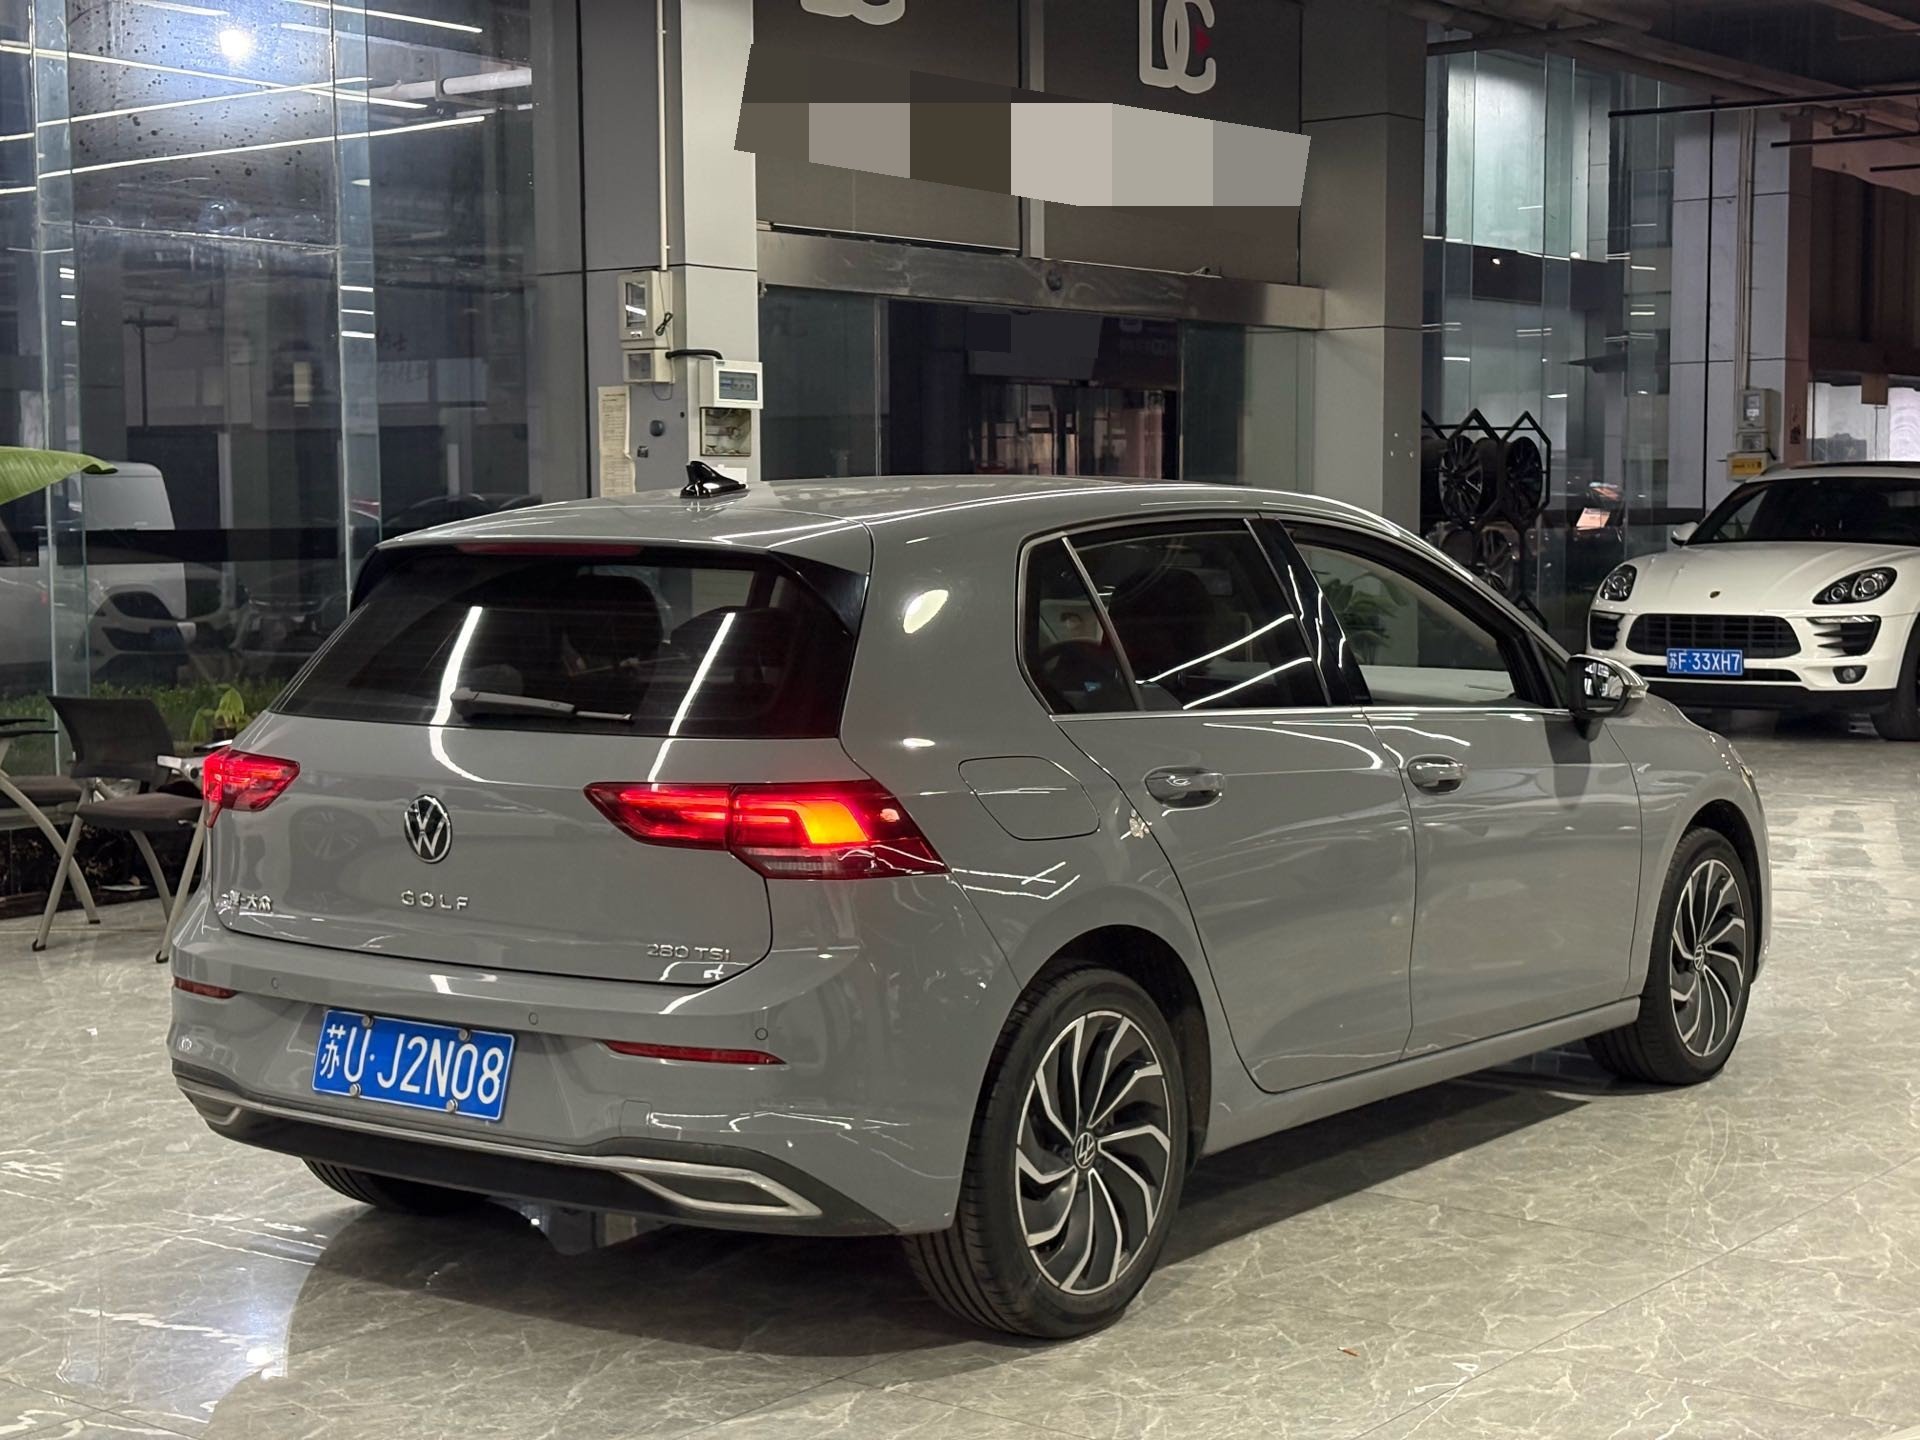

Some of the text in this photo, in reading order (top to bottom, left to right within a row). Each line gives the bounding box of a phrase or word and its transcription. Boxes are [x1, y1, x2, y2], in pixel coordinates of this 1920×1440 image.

[401, 890, 469, 910] GOLF
[647, 943, 730, 961] 280 TSI
